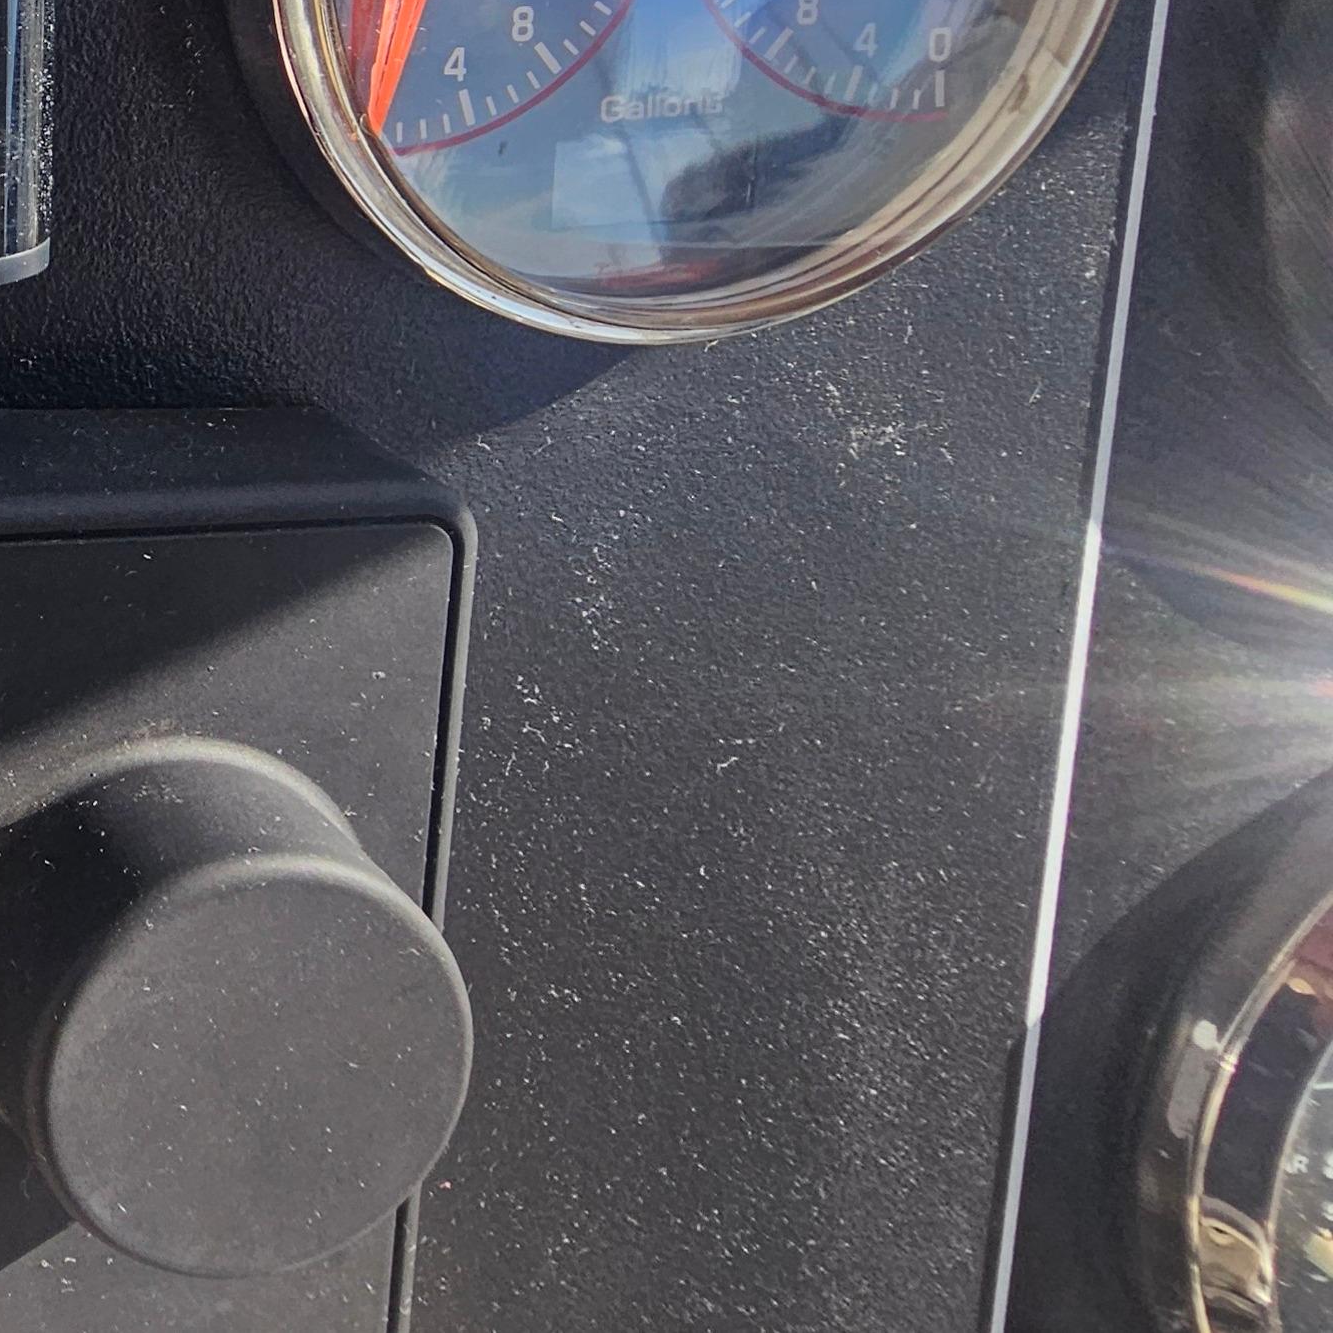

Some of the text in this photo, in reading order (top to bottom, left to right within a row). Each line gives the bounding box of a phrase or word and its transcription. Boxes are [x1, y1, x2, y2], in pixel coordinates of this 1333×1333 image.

[511, 6, 534, 42] 8
[853, 22, 878, 58] 4
[929, 27, 952, 63] 0
[444, 47, 467, 82] 4
